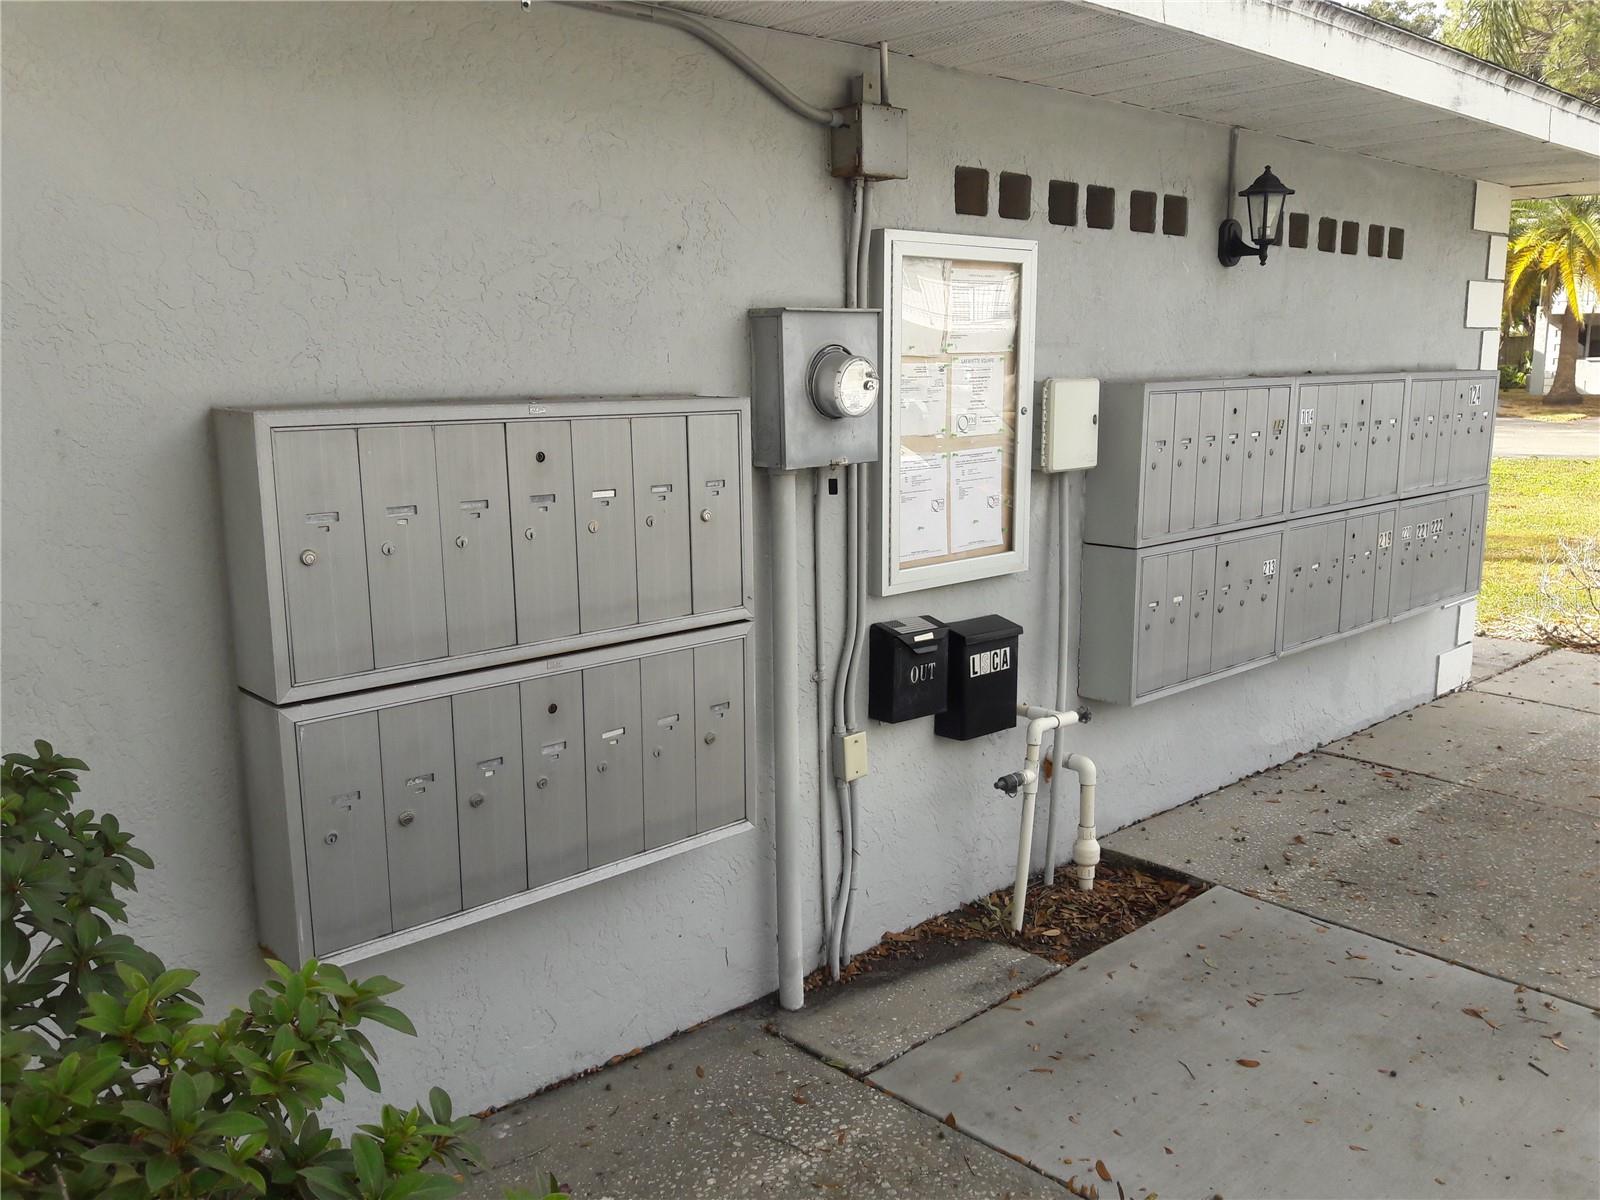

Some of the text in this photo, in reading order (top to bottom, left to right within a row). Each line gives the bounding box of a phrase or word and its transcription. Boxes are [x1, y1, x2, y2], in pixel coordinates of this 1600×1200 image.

[1416, 523, 1428, 538] 221
[1431, 519, 1443, 533] 222
[1379, 531, 1391, 547] 219
[1263, 560, 1275, 575] 213
[910, 662, 936, 683] OUT
